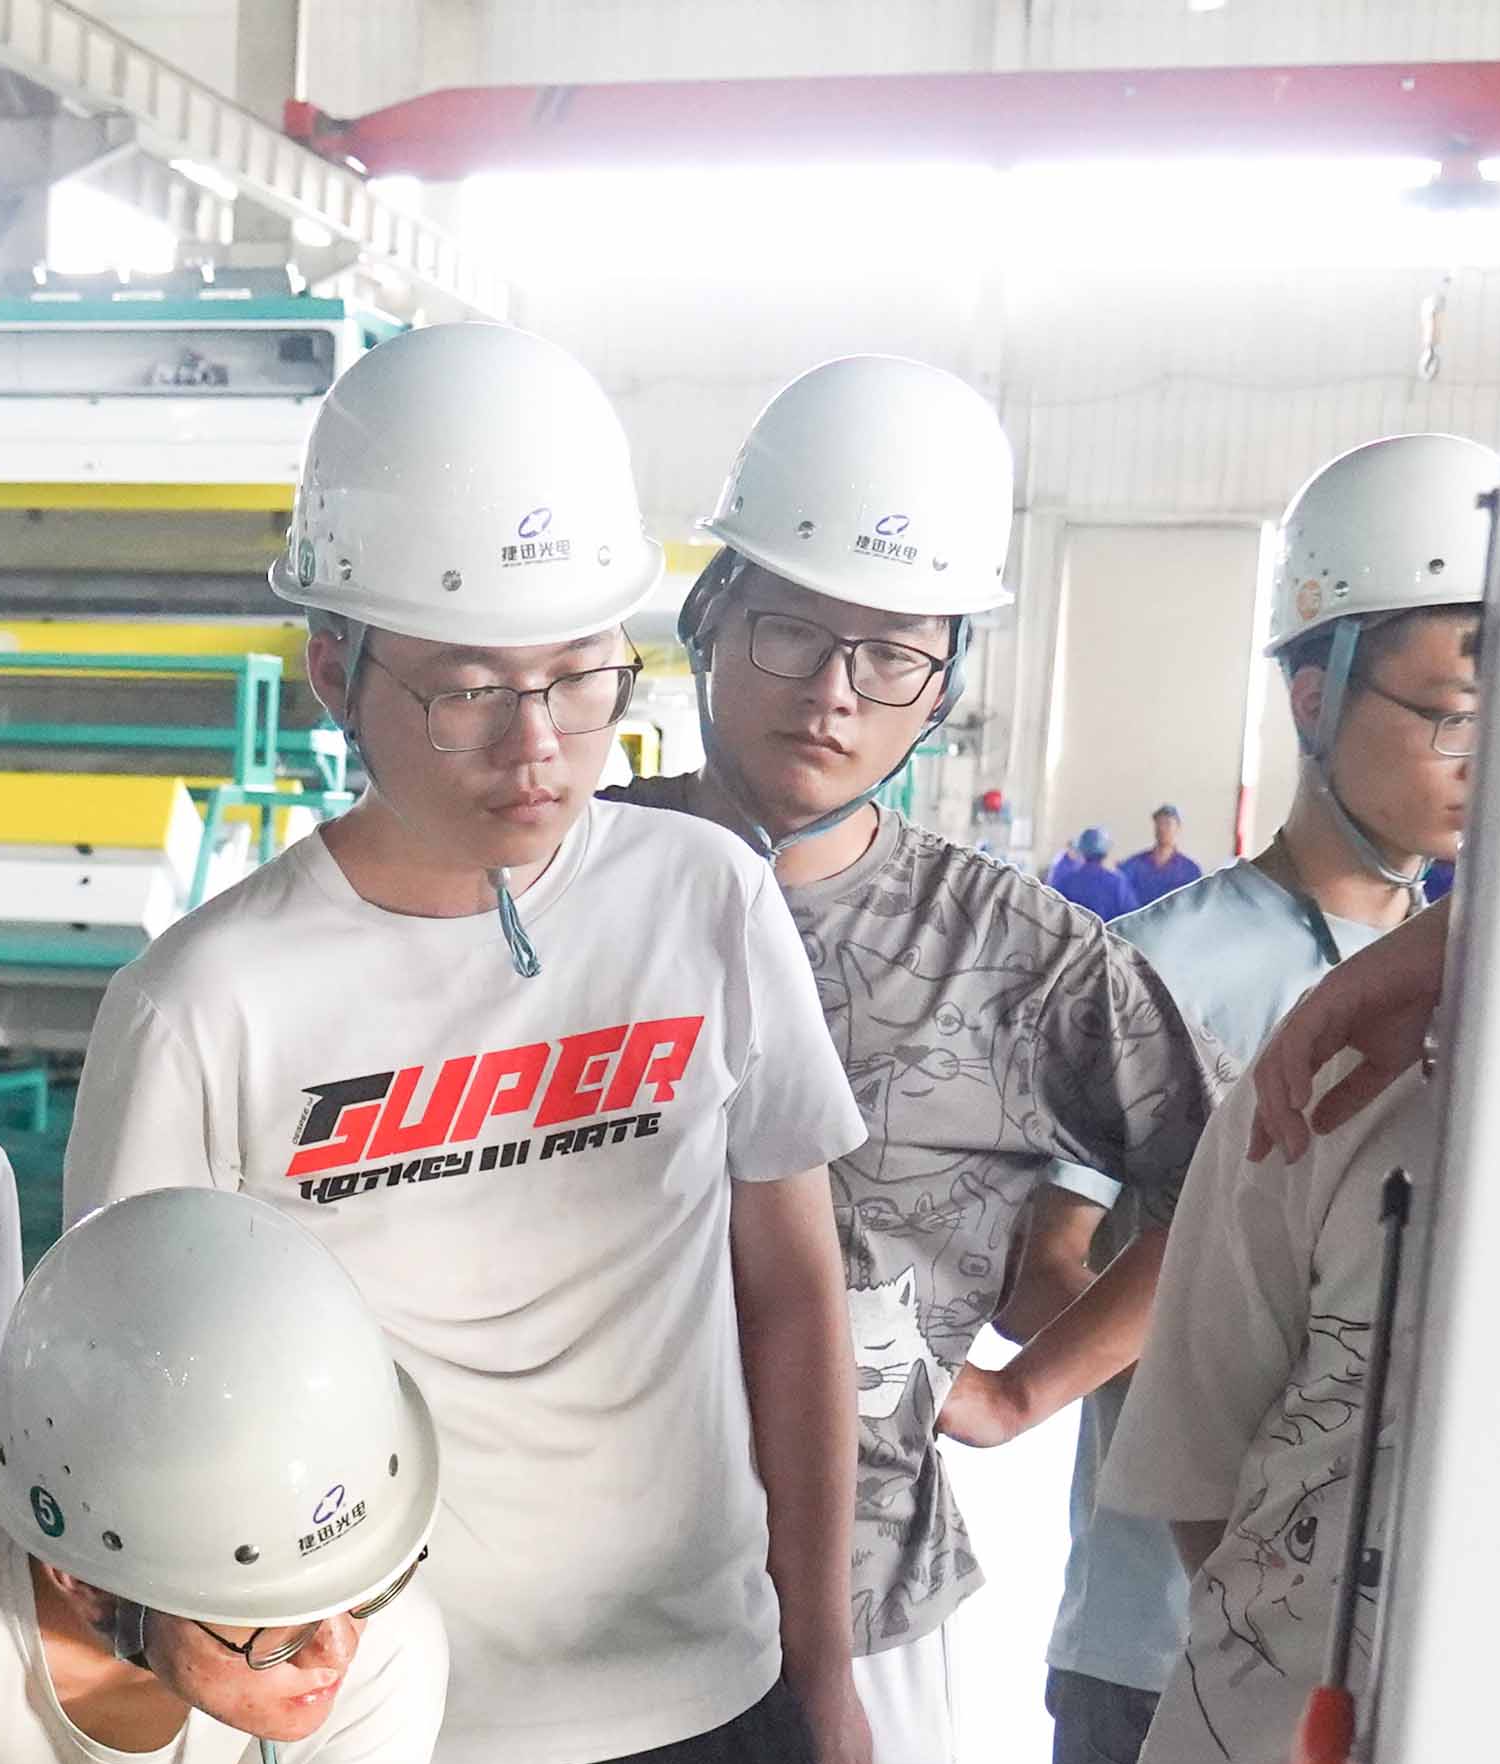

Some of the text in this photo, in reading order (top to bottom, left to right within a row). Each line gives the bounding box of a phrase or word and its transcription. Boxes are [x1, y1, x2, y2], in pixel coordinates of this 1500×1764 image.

[285, 1015, 705, 1177] SUPER
[298, 1150, 474, 1204] HOTKEY
[538, 1112, 662, 1161] RATE
[39, 1490, 55, 1526] 5
